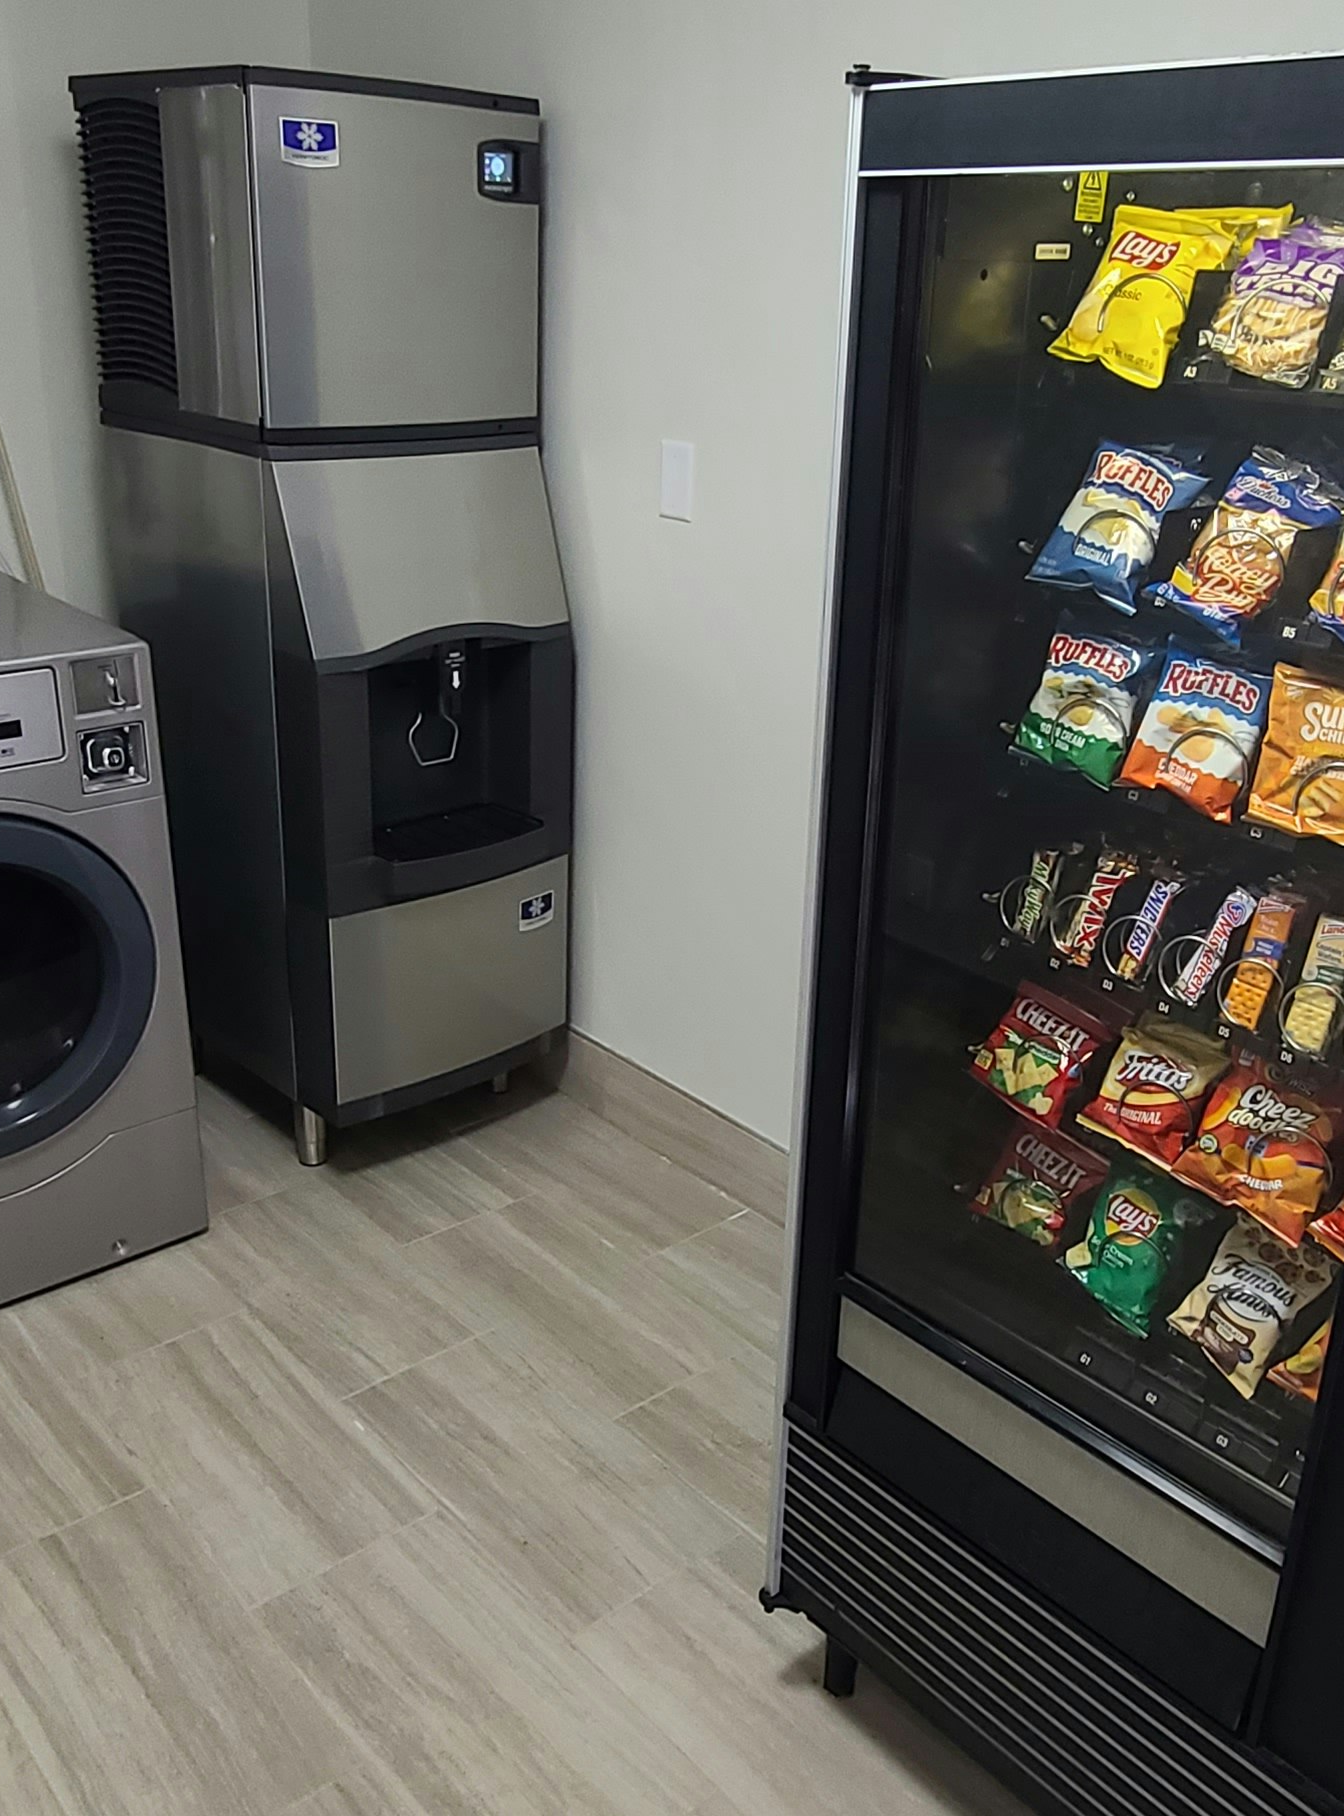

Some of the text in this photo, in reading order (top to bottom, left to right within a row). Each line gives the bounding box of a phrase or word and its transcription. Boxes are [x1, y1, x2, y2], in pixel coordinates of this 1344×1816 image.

[1111, 232, 1177, 268] Lay's
[1103, 284, 1142, 301] Cassic
[1183, 366, 1198, 378] A3
[1322, 378, 1338, 390] A5
[1094, 453, 1172, 508] RUFFLES
[1282, 627, 1297, 639] B5
[1051, 635, 1130, 681] RUFFLES
[1162, 663, 1259, 713] RUFFLES
[1040, 722, 1087, 748] SOR CREAM
[1075, 869, 1136, 950] TWIX
[1128, 880, 1169, 957] SNICKERS
[1158, 1002, 1170, 1014] D4
[1218, 1025, 1230, 1038] D5
[1280, 1051, 1293, 1064] D6
[1116, 1050, 1192, 1091] Fritos
[1103, 1103, 1162, 1126] The ORIGINAL
[1239, 1084, 1317, 1130] Cheez
[1109, 1195, 1157, 1233] Lay's
[1211, 1253, 1298, 1308] Famous
[1080, 1353, 1092, 1365] G1
[1145, 1392, 1158, 1405] G2
[1216, 1434, 1229, 1447] G3
